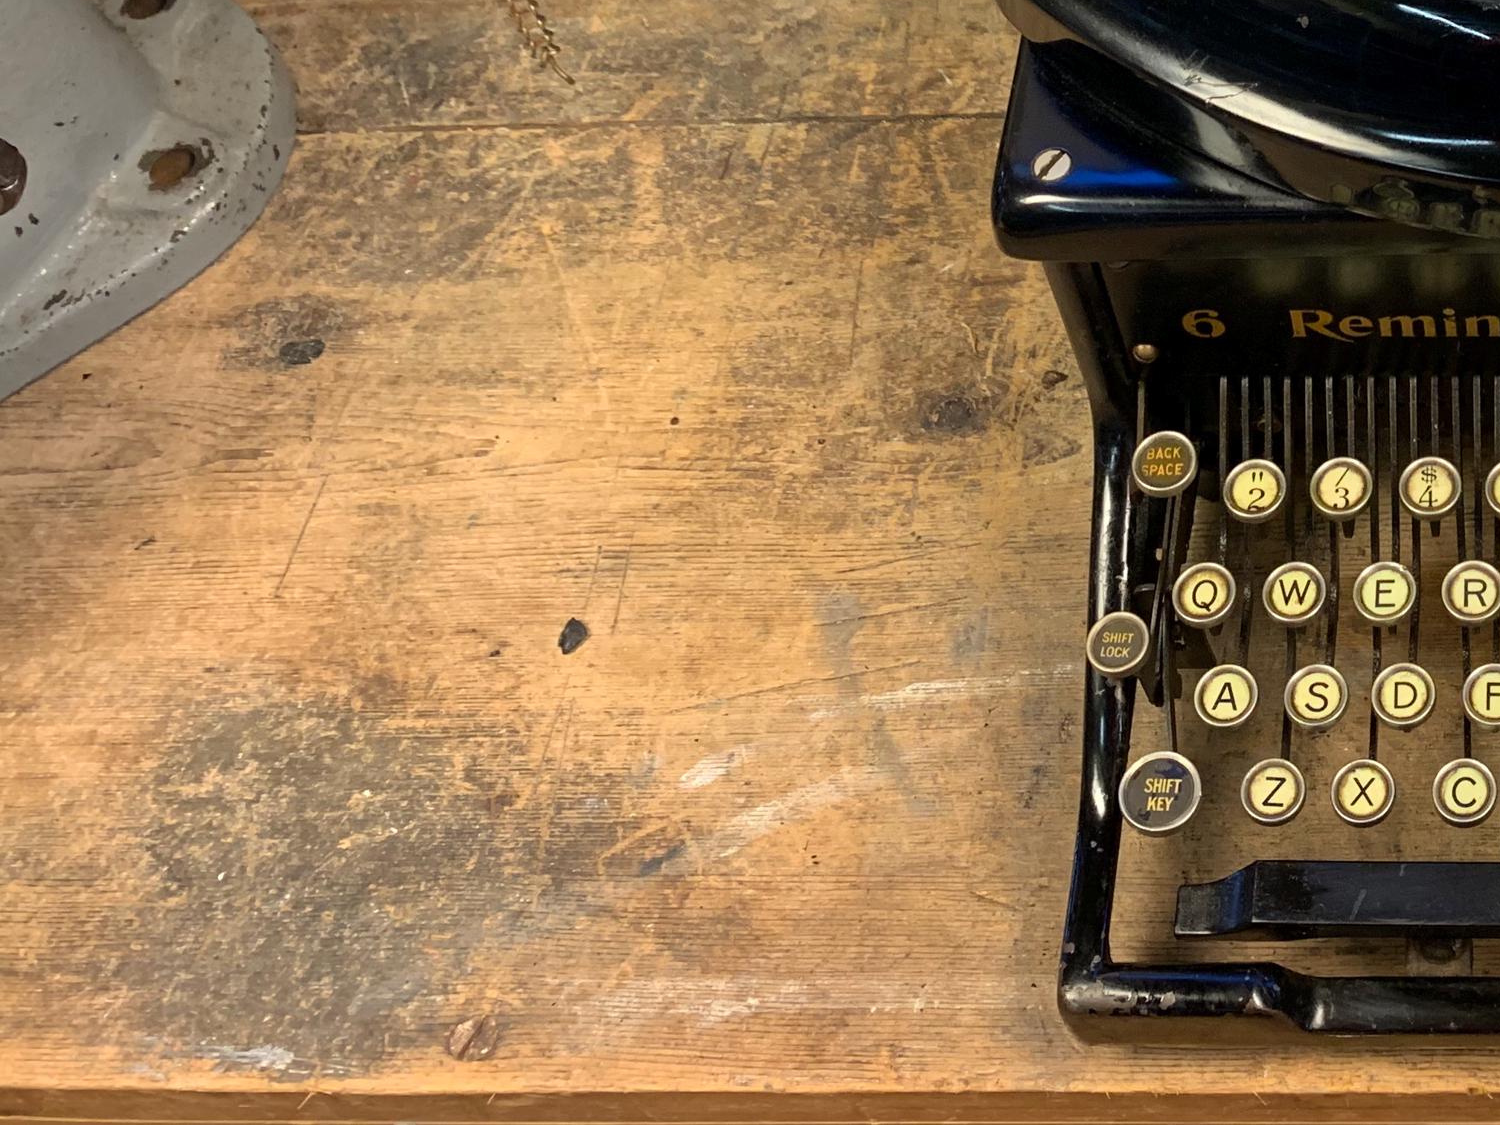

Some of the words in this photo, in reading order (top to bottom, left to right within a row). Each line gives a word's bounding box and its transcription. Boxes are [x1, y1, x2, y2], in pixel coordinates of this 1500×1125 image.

[1182, 310, 1226, 338] 6
[1146, 447, 1182, 460] BACK
[1141, 463, 1185, 476] SPACE
[1248, 488, 1265, 511] 2
[1333, 487, 1350, 509] 3
[1419, 487, 1438, 509] 4
[1192, 579, 1218, 612] Q
[1279, 579, 1312, 606] W
[1375, 580, 1396, 608] E
[1465, 579, 1488, 607] R
[1102, 631, 1134, 644] SHIFT
[1100, 646, 1131, 658] LOCK
[1212, 681, 1238, 711] A
[1305, 682, 1329, 711] S
[1394, 681, 1417, 708] D
[1144, 778, 1182, 793] SHIFT
[1262, 777, 1284, 807] Z
[1352, 777, 1375, 806] X
[1451, 778, 1476, 807] C
[1146, 797, 1175, 812] KEY
